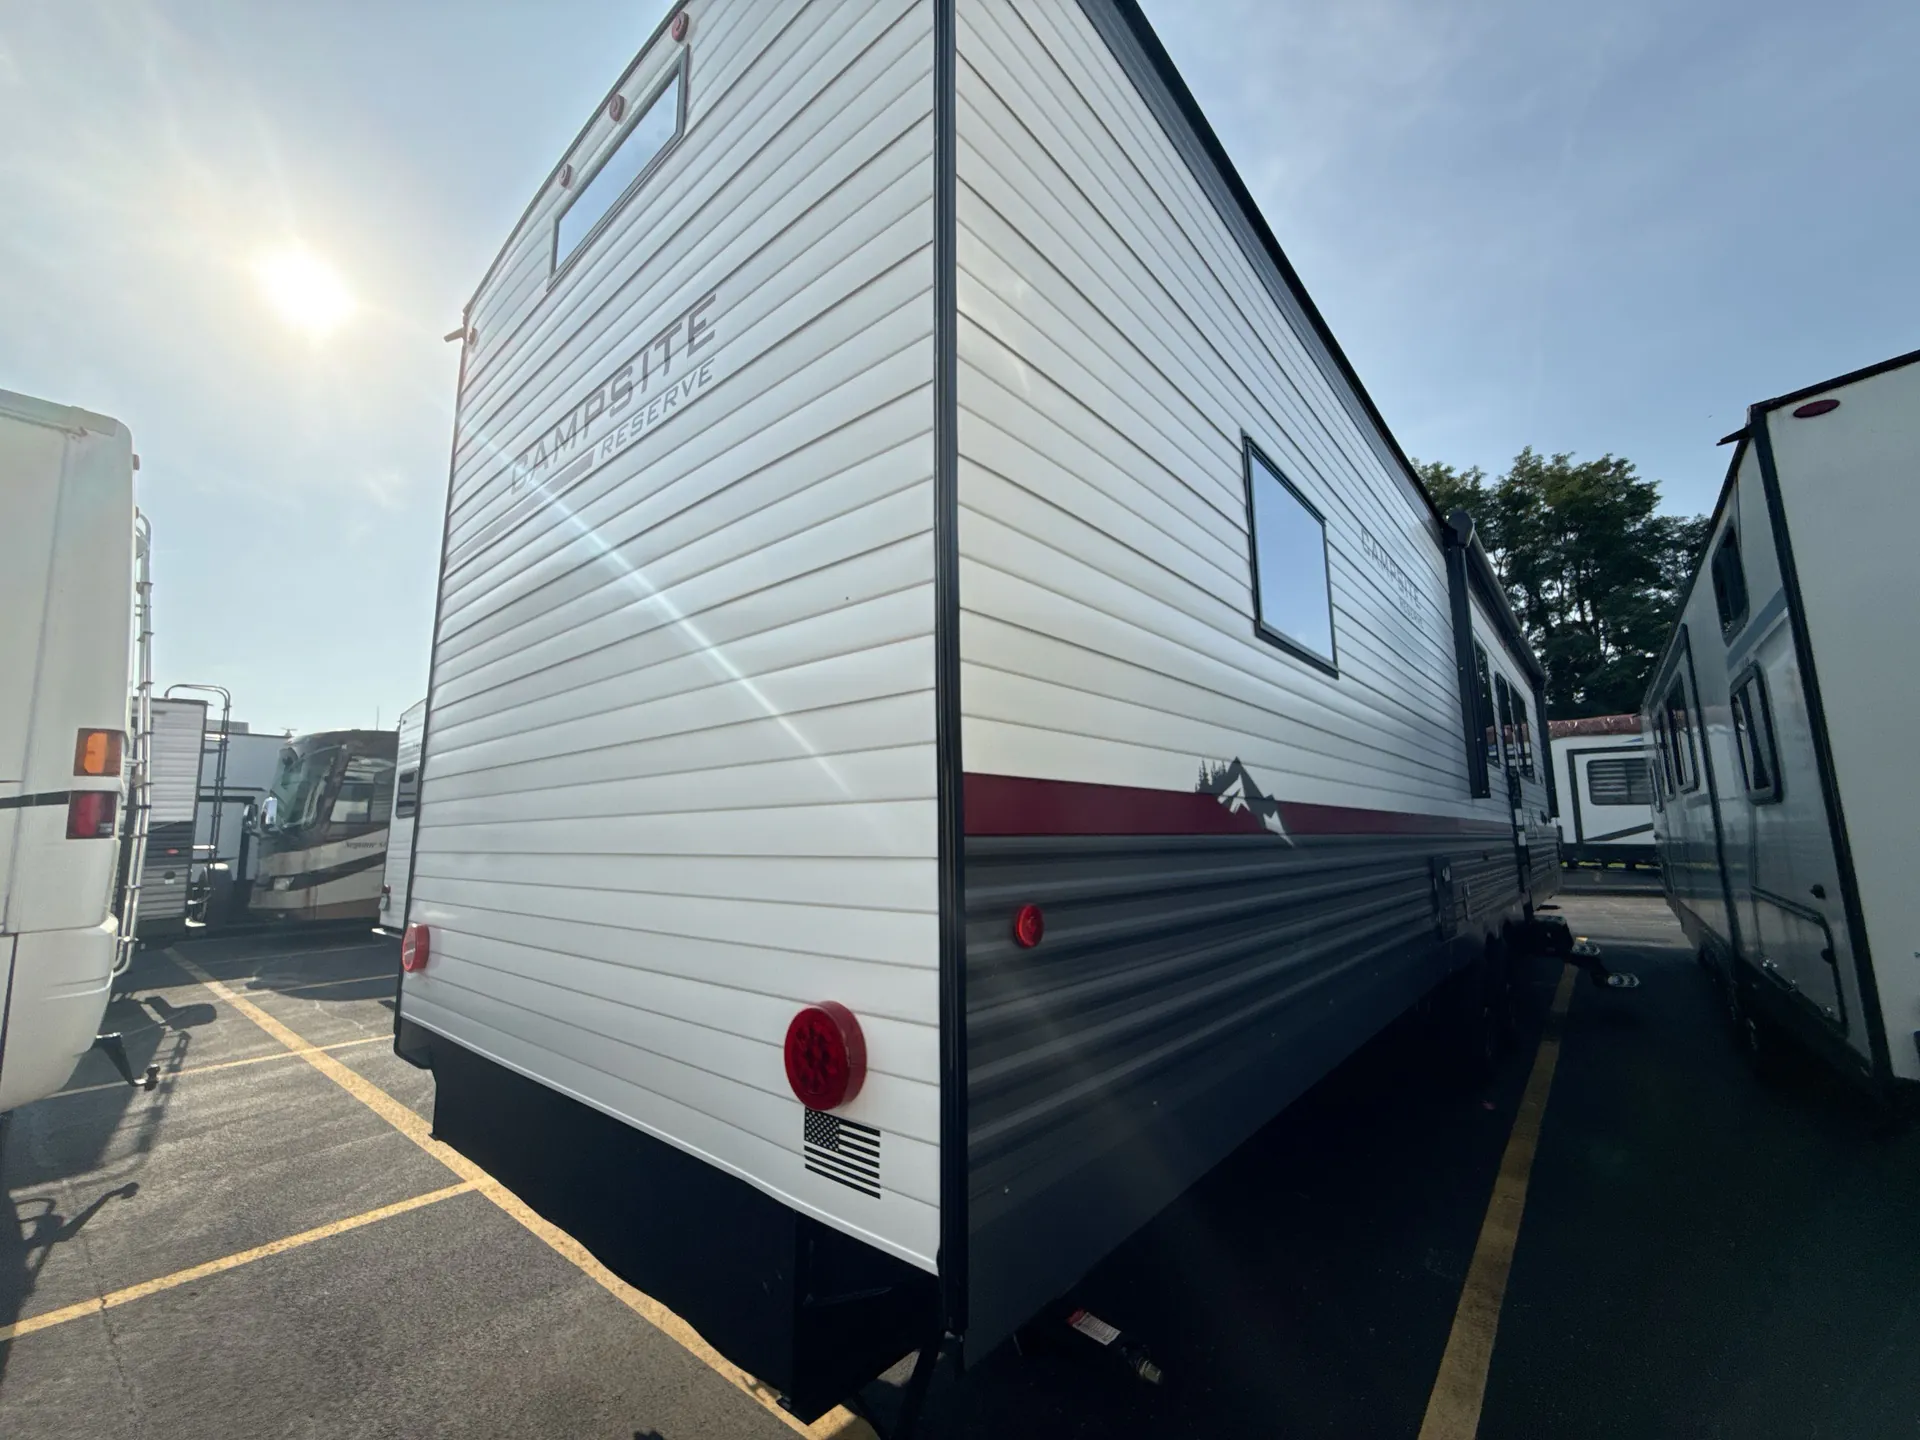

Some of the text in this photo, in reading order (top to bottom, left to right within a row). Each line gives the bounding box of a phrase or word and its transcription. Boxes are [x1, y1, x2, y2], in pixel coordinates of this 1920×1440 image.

[511, 293, 717, 495] CAMPSITE
[600, 358, 716, 459] RESERVE
[1361, 527, 1422, 610] CAMPSITE
